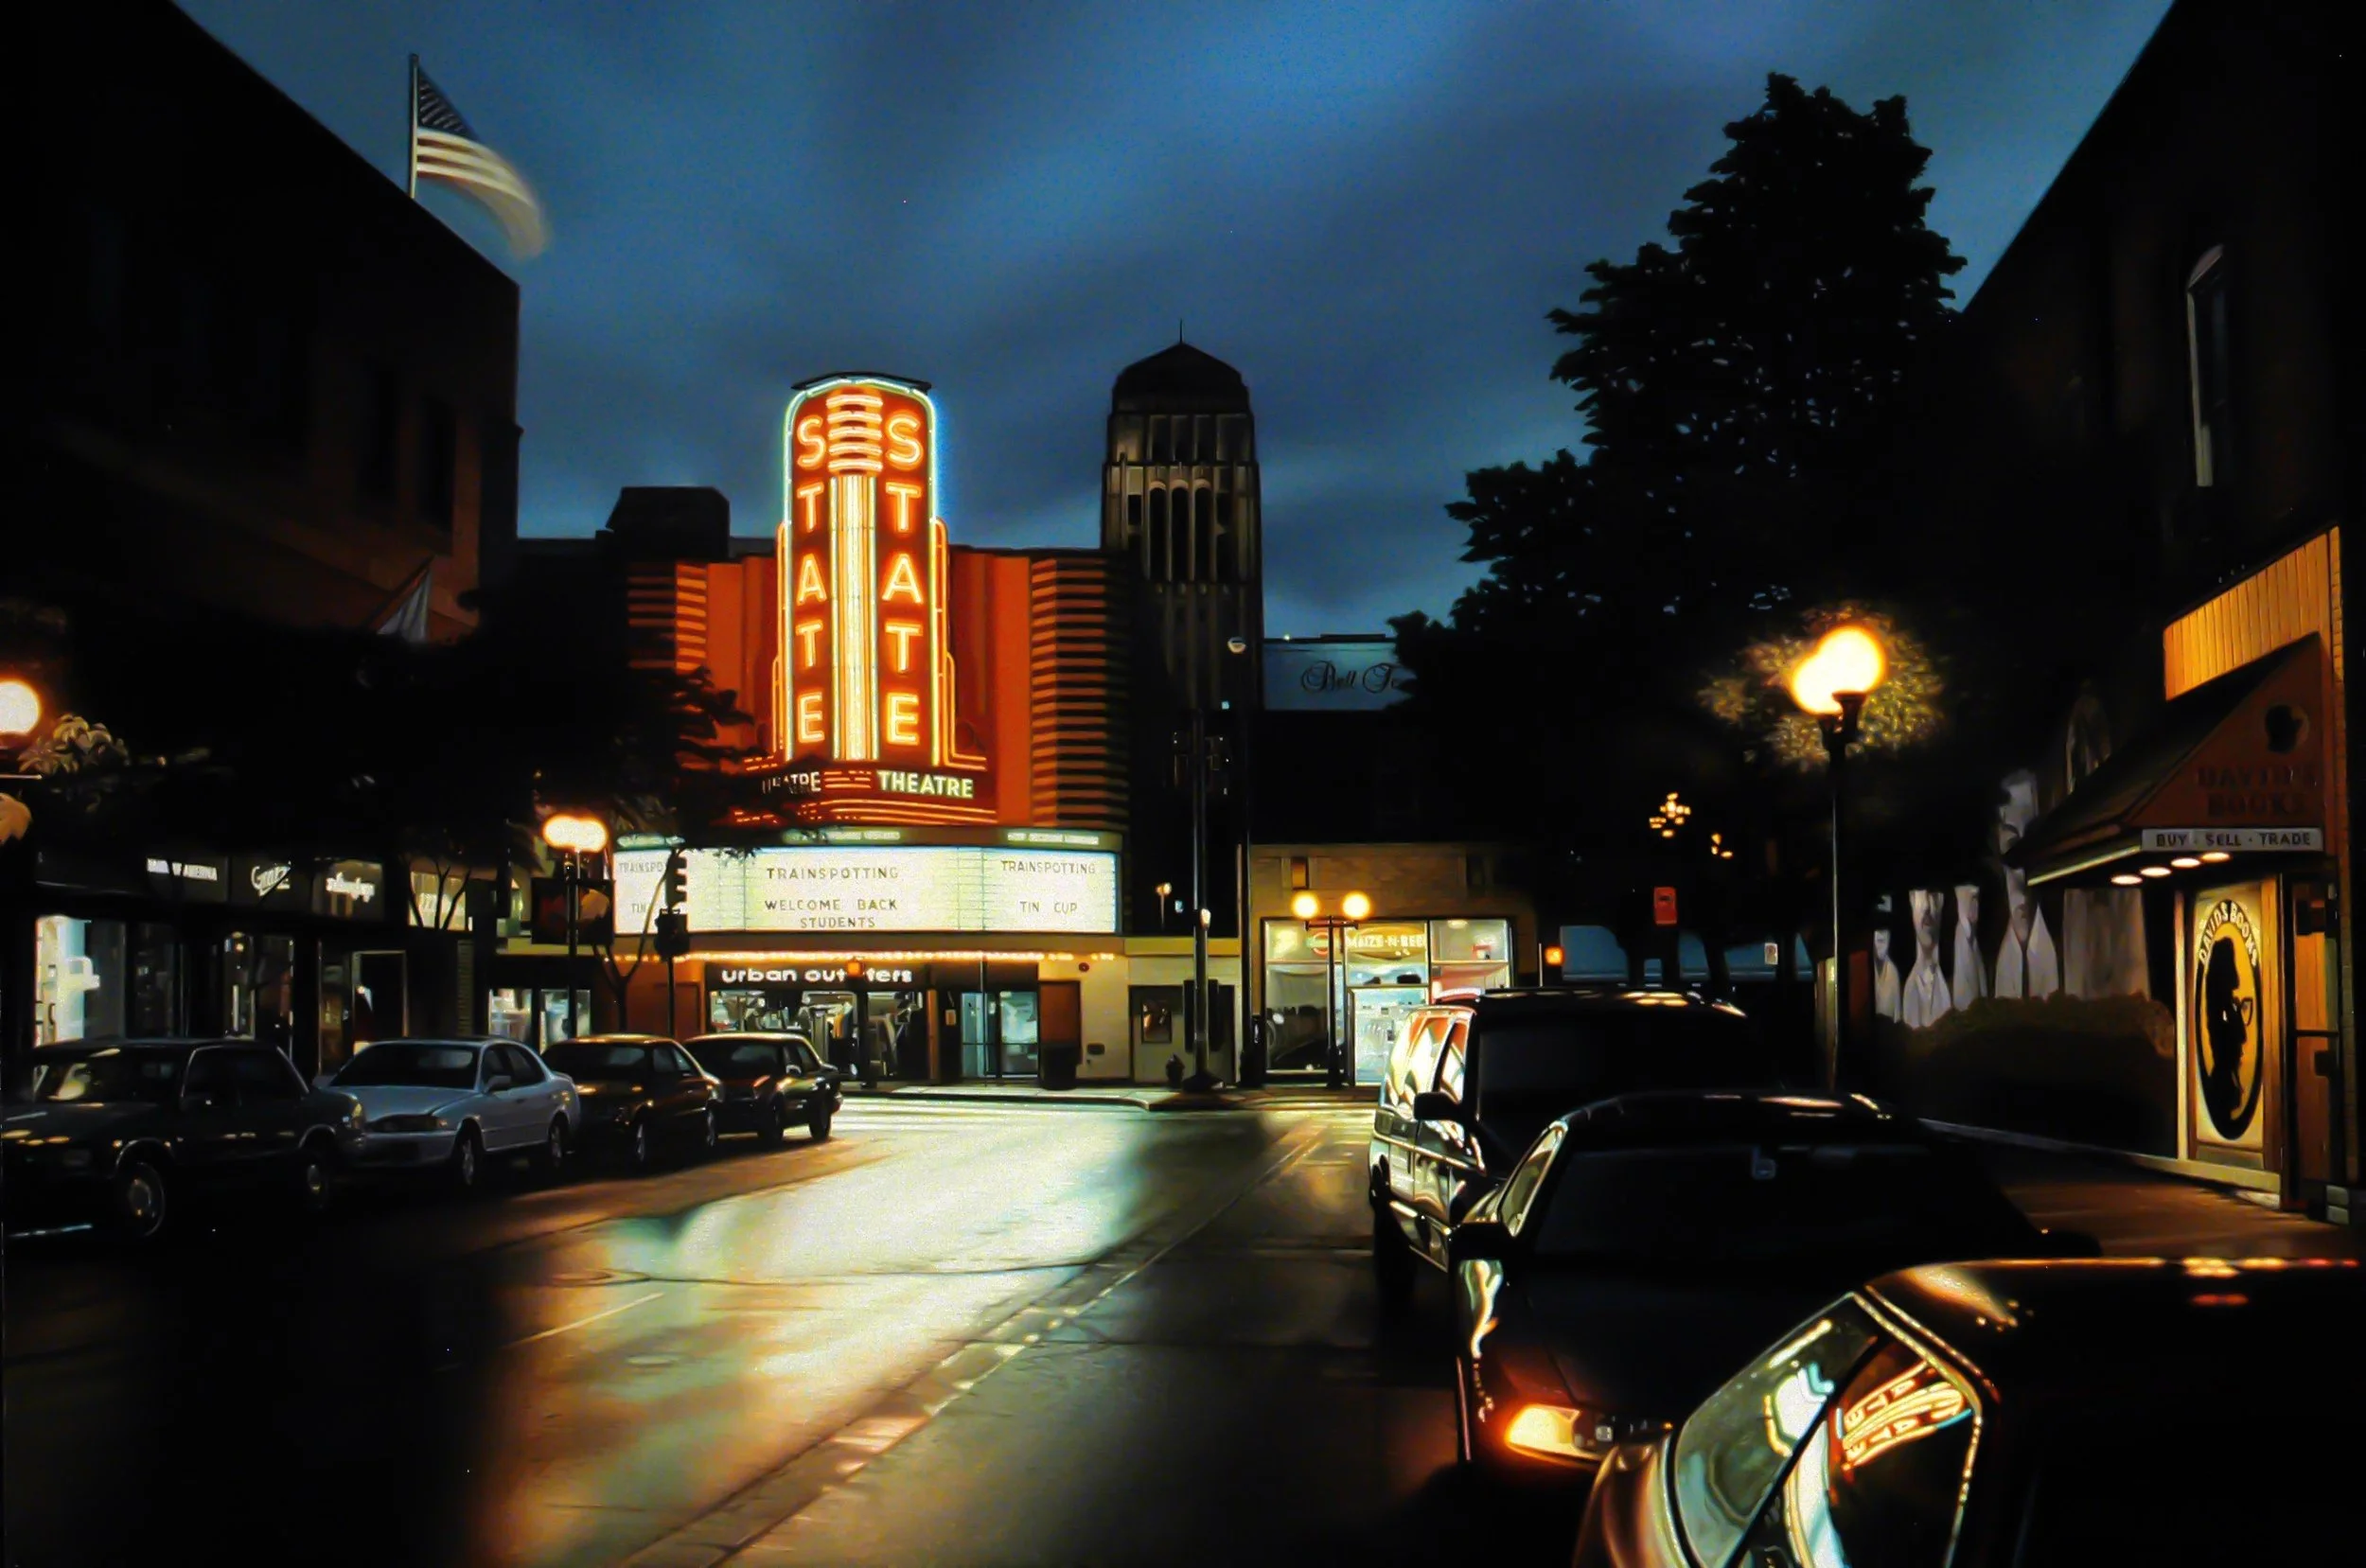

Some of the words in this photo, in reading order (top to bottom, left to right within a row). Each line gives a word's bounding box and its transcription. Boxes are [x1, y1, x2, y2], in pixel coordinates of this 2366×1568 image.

[796, 414, 827, 745] STATE
[881, 414, 925, 747] STATE
[876, 769, 974, 799] THEATRE
[2156, 834, 2187, 847] BUY
[2205, 834, 2242, 847] SELL
[2258, 832, 2310, 847] TRADE
[619, 862, 664, 873] TRAINSPO
[767, 867, 899, 879] TRAINSPOTTING
[1000, 859, 1096, 873] TRAINSPOTTING
[764, 899, 840, 911] WELCOME
[857, 899, 897, 911] BACK
[1019, 901, 1039, 913] TIN
[1053, 901, 1077, 915] CUP
[801, 916, 875, 928] STUDENTS
[721, 968, 797, 983] urban
[804, 967, 912, 983] outters
